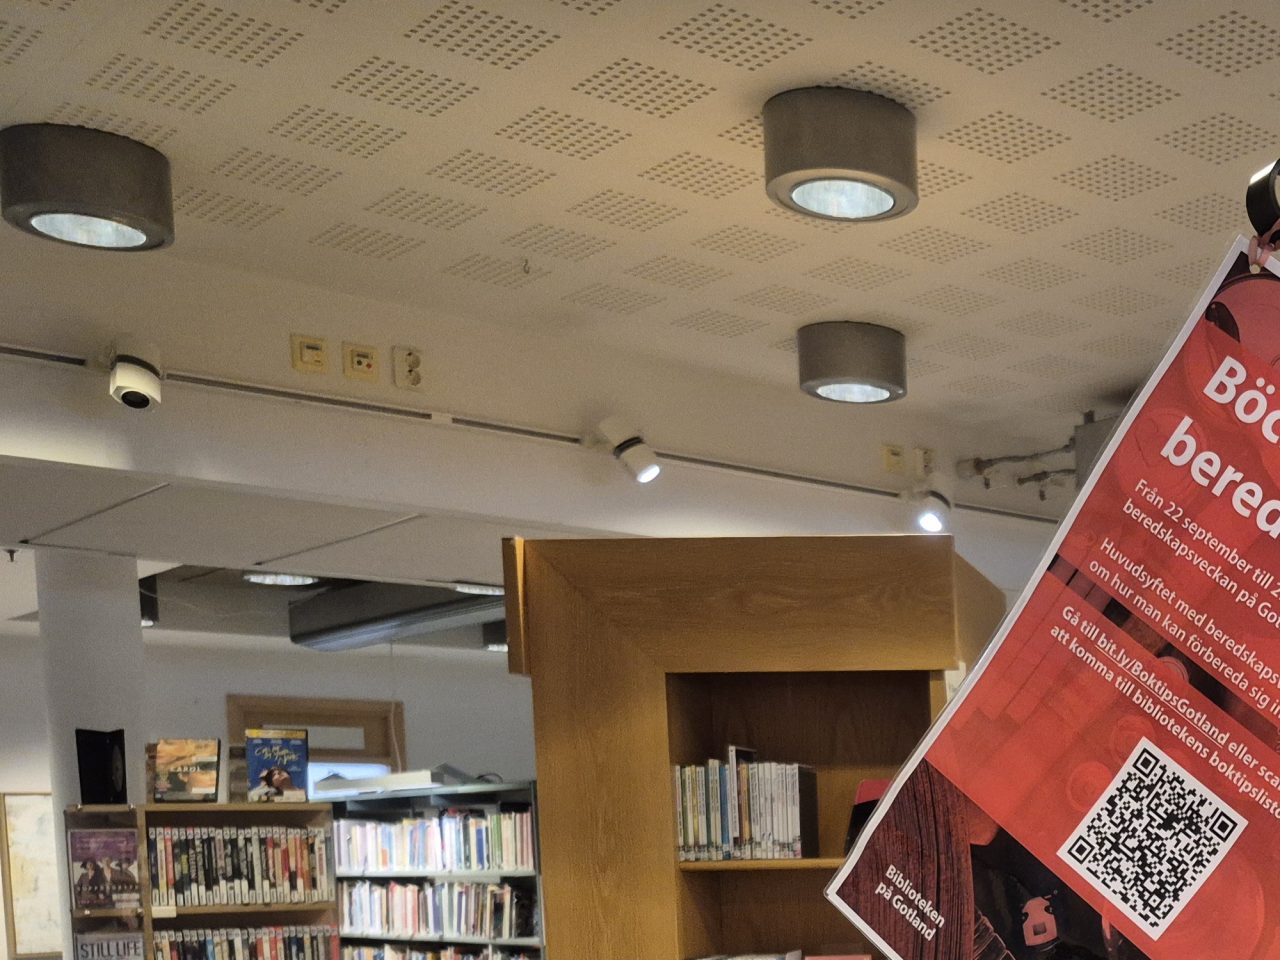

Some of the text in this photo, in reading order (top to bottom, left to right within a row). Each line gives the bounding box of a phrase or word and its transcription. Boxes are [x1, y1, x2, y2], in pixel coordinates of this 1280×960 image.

[1100, 537, 1176, 604] Huvudsyftet
[1174, 599, 1207, 627] med
[1122, 497, 1238, 594] beredskapsveckan
[1235, 589, 1259, 608] på
[1135, 478, 1164, 509] Från
[1163, 501, 1183, 522] 22
[1181, 517, 1253, 574] september
[1252, 568, 1274, 589] till
[1062, 606, 1081, 626] Gå
[1080, 620, 1100, 641] till
[1094, 632, 1230, 748] bit.ly/BoktipsGotland
[1227, 741, 1259, 768] eller
[1089, 560, 1110, 582] om
[1110, 572, 1134, 598] hur
[1132, 594, 1161, 622] man
[1161, 613, 1186, 642] kan
[1186, 634, 1249, 691] förbereda
[1248, 686, 1270, 709] sig
[1050, 625, 1070, 645] att
[1068, 637, 1114, 682] komma
[1114, 675, 1135, 696] till
[1132, 688, 1209, 758] bibliotekens
[81, 940, 141, 959] STILL LIFE
[874, 881, 936, 941] på Gotland
[885, 864, 945, 928] Biblioteken
